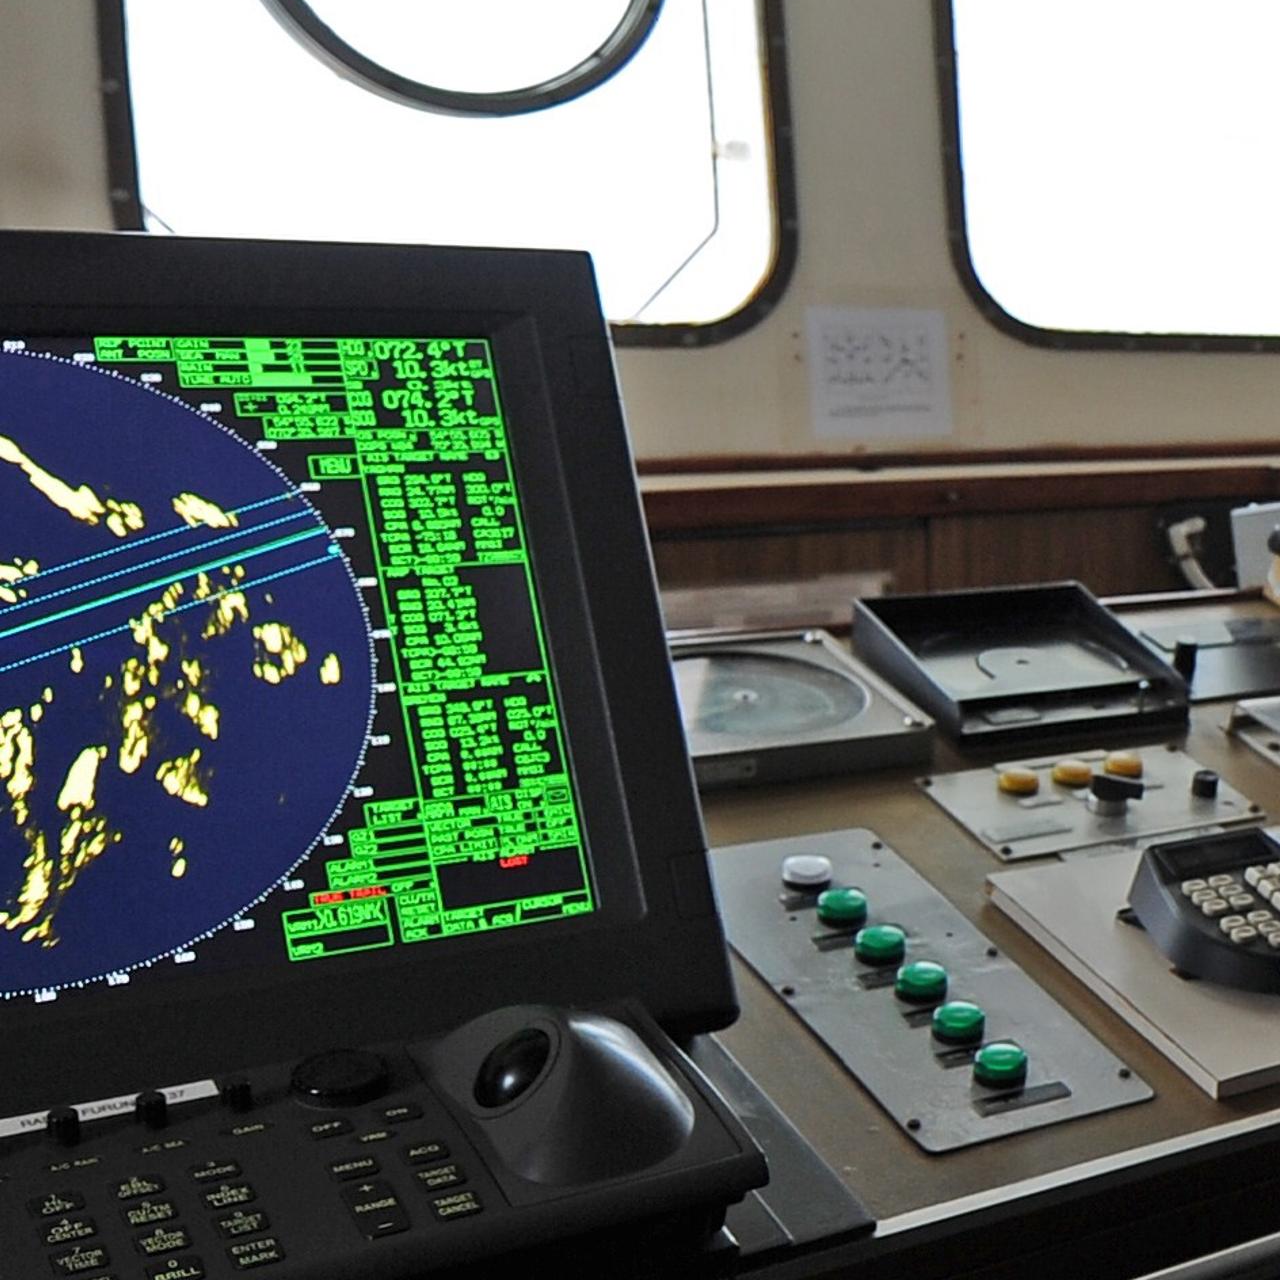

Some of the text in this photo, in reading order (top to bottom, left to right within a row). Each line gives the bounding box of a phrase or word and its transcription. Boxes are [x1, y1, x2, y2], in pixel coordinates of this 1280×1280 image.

[500, 854, 530, 869] LOST
[354, 1197, 397, 1213] RANGE
[231, 1238, 275, 1255] ENTER
[238, 1250, 279, 1266] MARK
